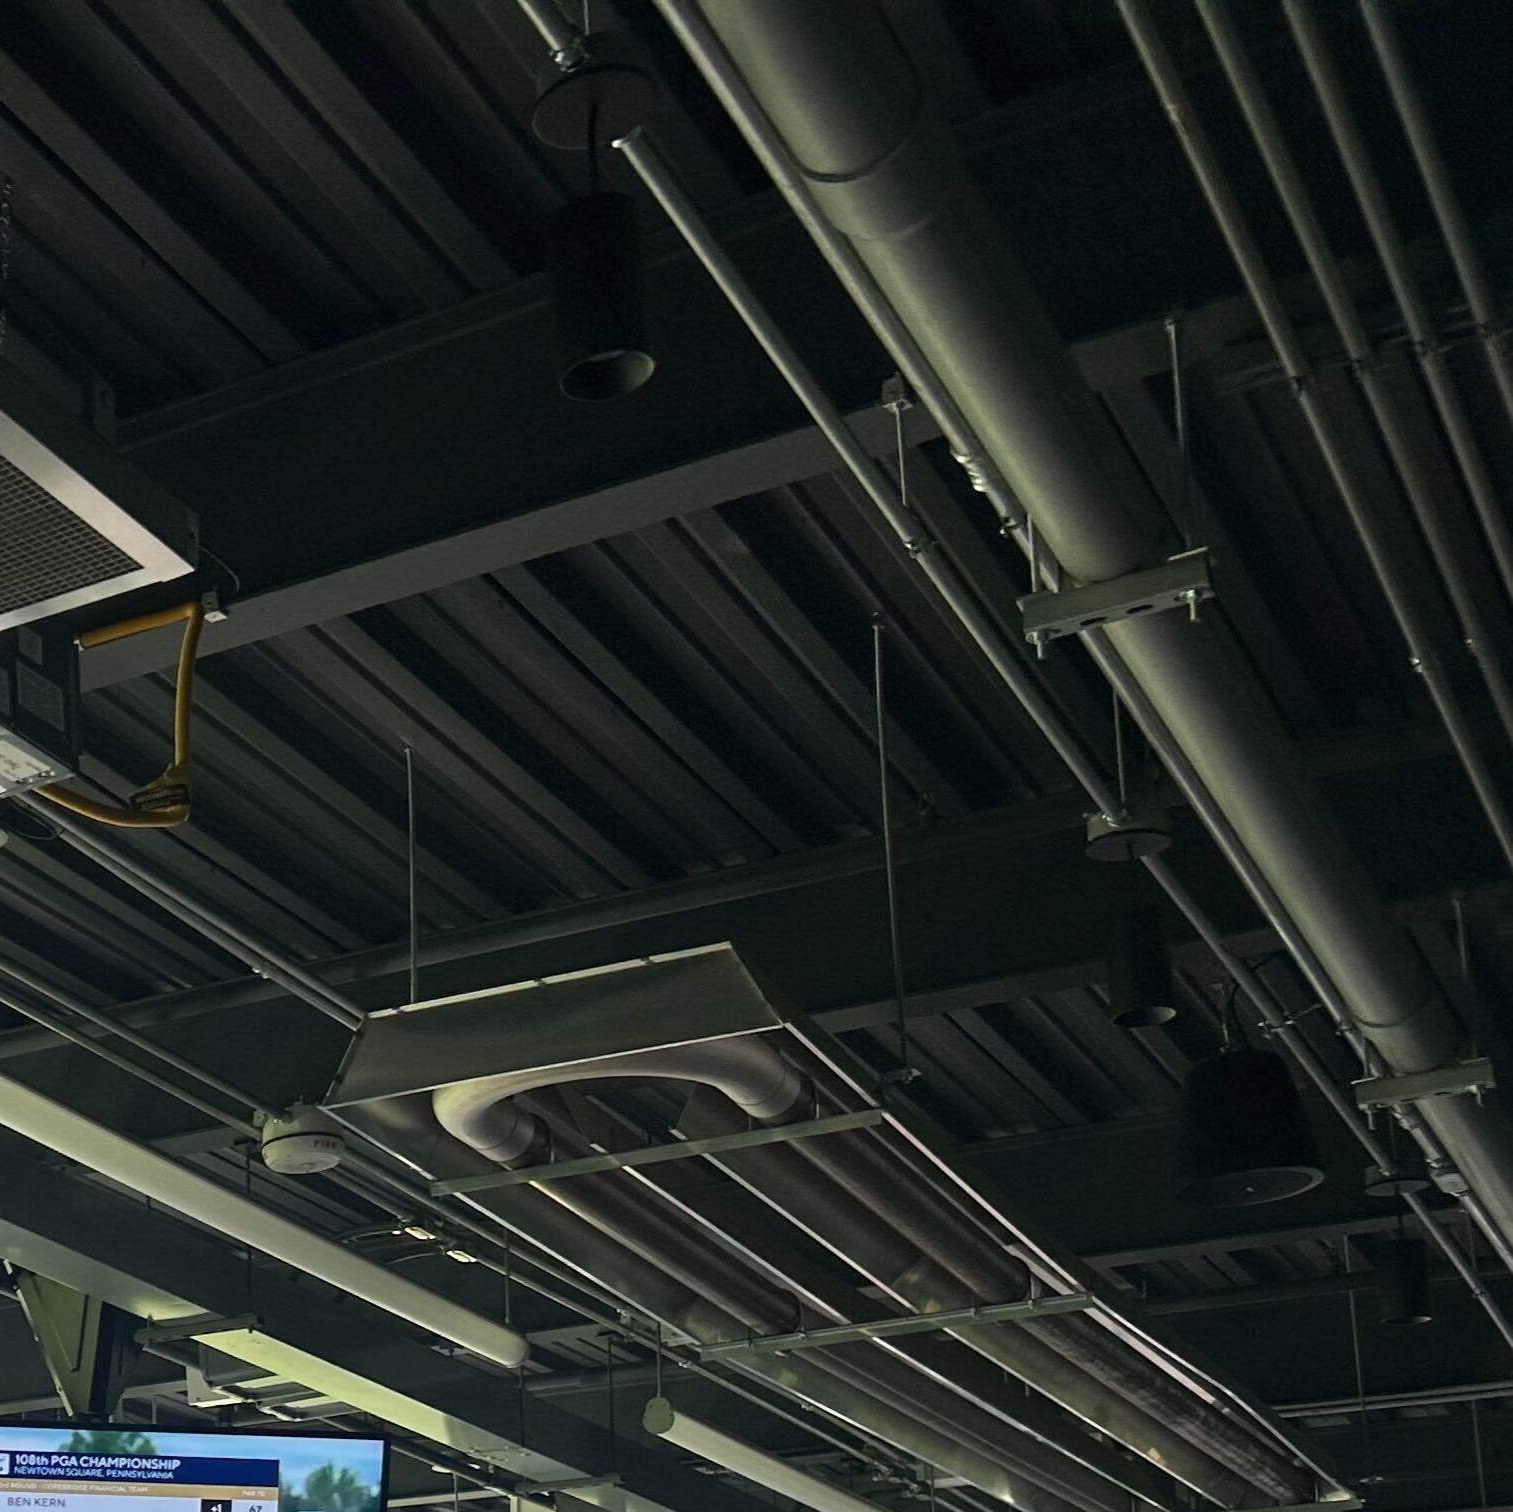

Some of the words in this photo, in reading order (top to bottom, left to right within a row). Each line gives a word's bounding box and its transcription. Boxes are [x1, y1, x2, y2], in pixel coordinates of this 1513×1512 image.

[15, 1454, 49, 1466] 108th
[50, 1455, 77, 1467] PGA
[81, 1456, 181, 1470] CHAMPIONSHIP
[14, 1466, 64, 1476] NEWTOWN
[107, 1470, 173, 1479] PENNSYLVANIA
[7, 1497, 32, 1506] BEN
[35, 1498, 65, 1507] KERN
[211, 1504, 222, 1512] +1
